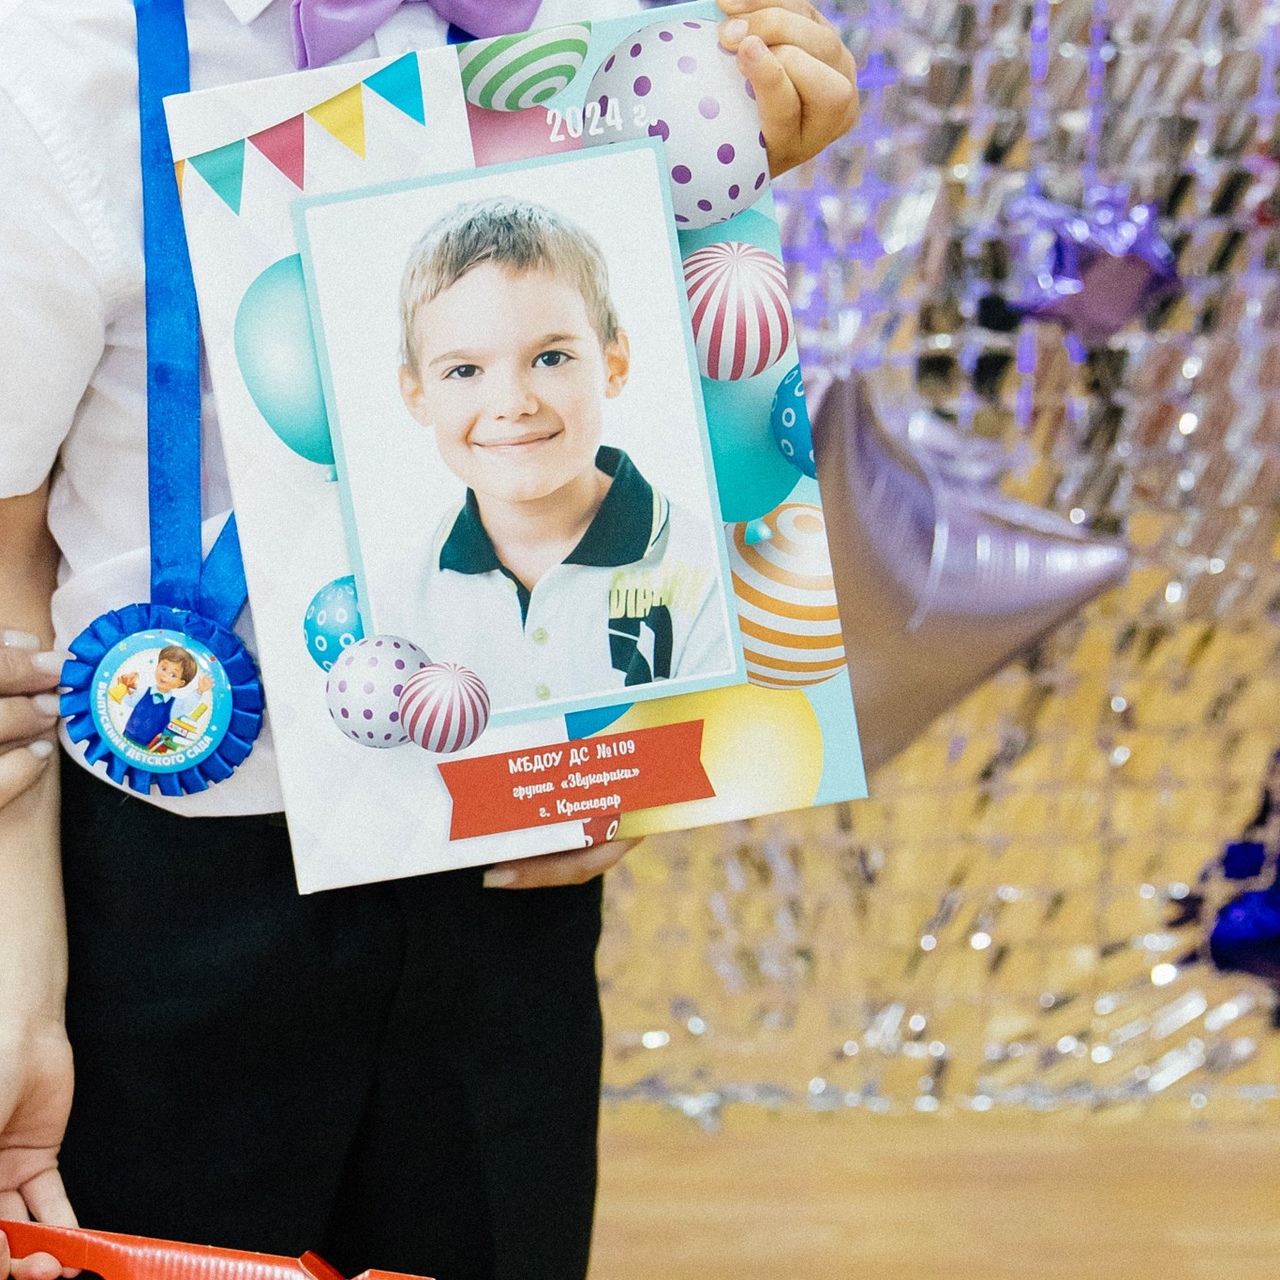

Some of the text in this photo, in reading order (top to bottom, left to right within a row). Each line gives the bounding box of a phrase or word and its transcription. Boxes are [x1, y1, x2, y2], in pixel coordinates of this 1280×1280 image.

[546, 98, 623, 142] 2024
[125, 748, 186, 766] ДЕТСКОГО
[187, 734, 214, 759] САДА
[508, 740, 636, 774] МБДОУ ДС №109
[512, 782, 555, 800] группа
[539, 793, 621, 818] г. Краснодар
